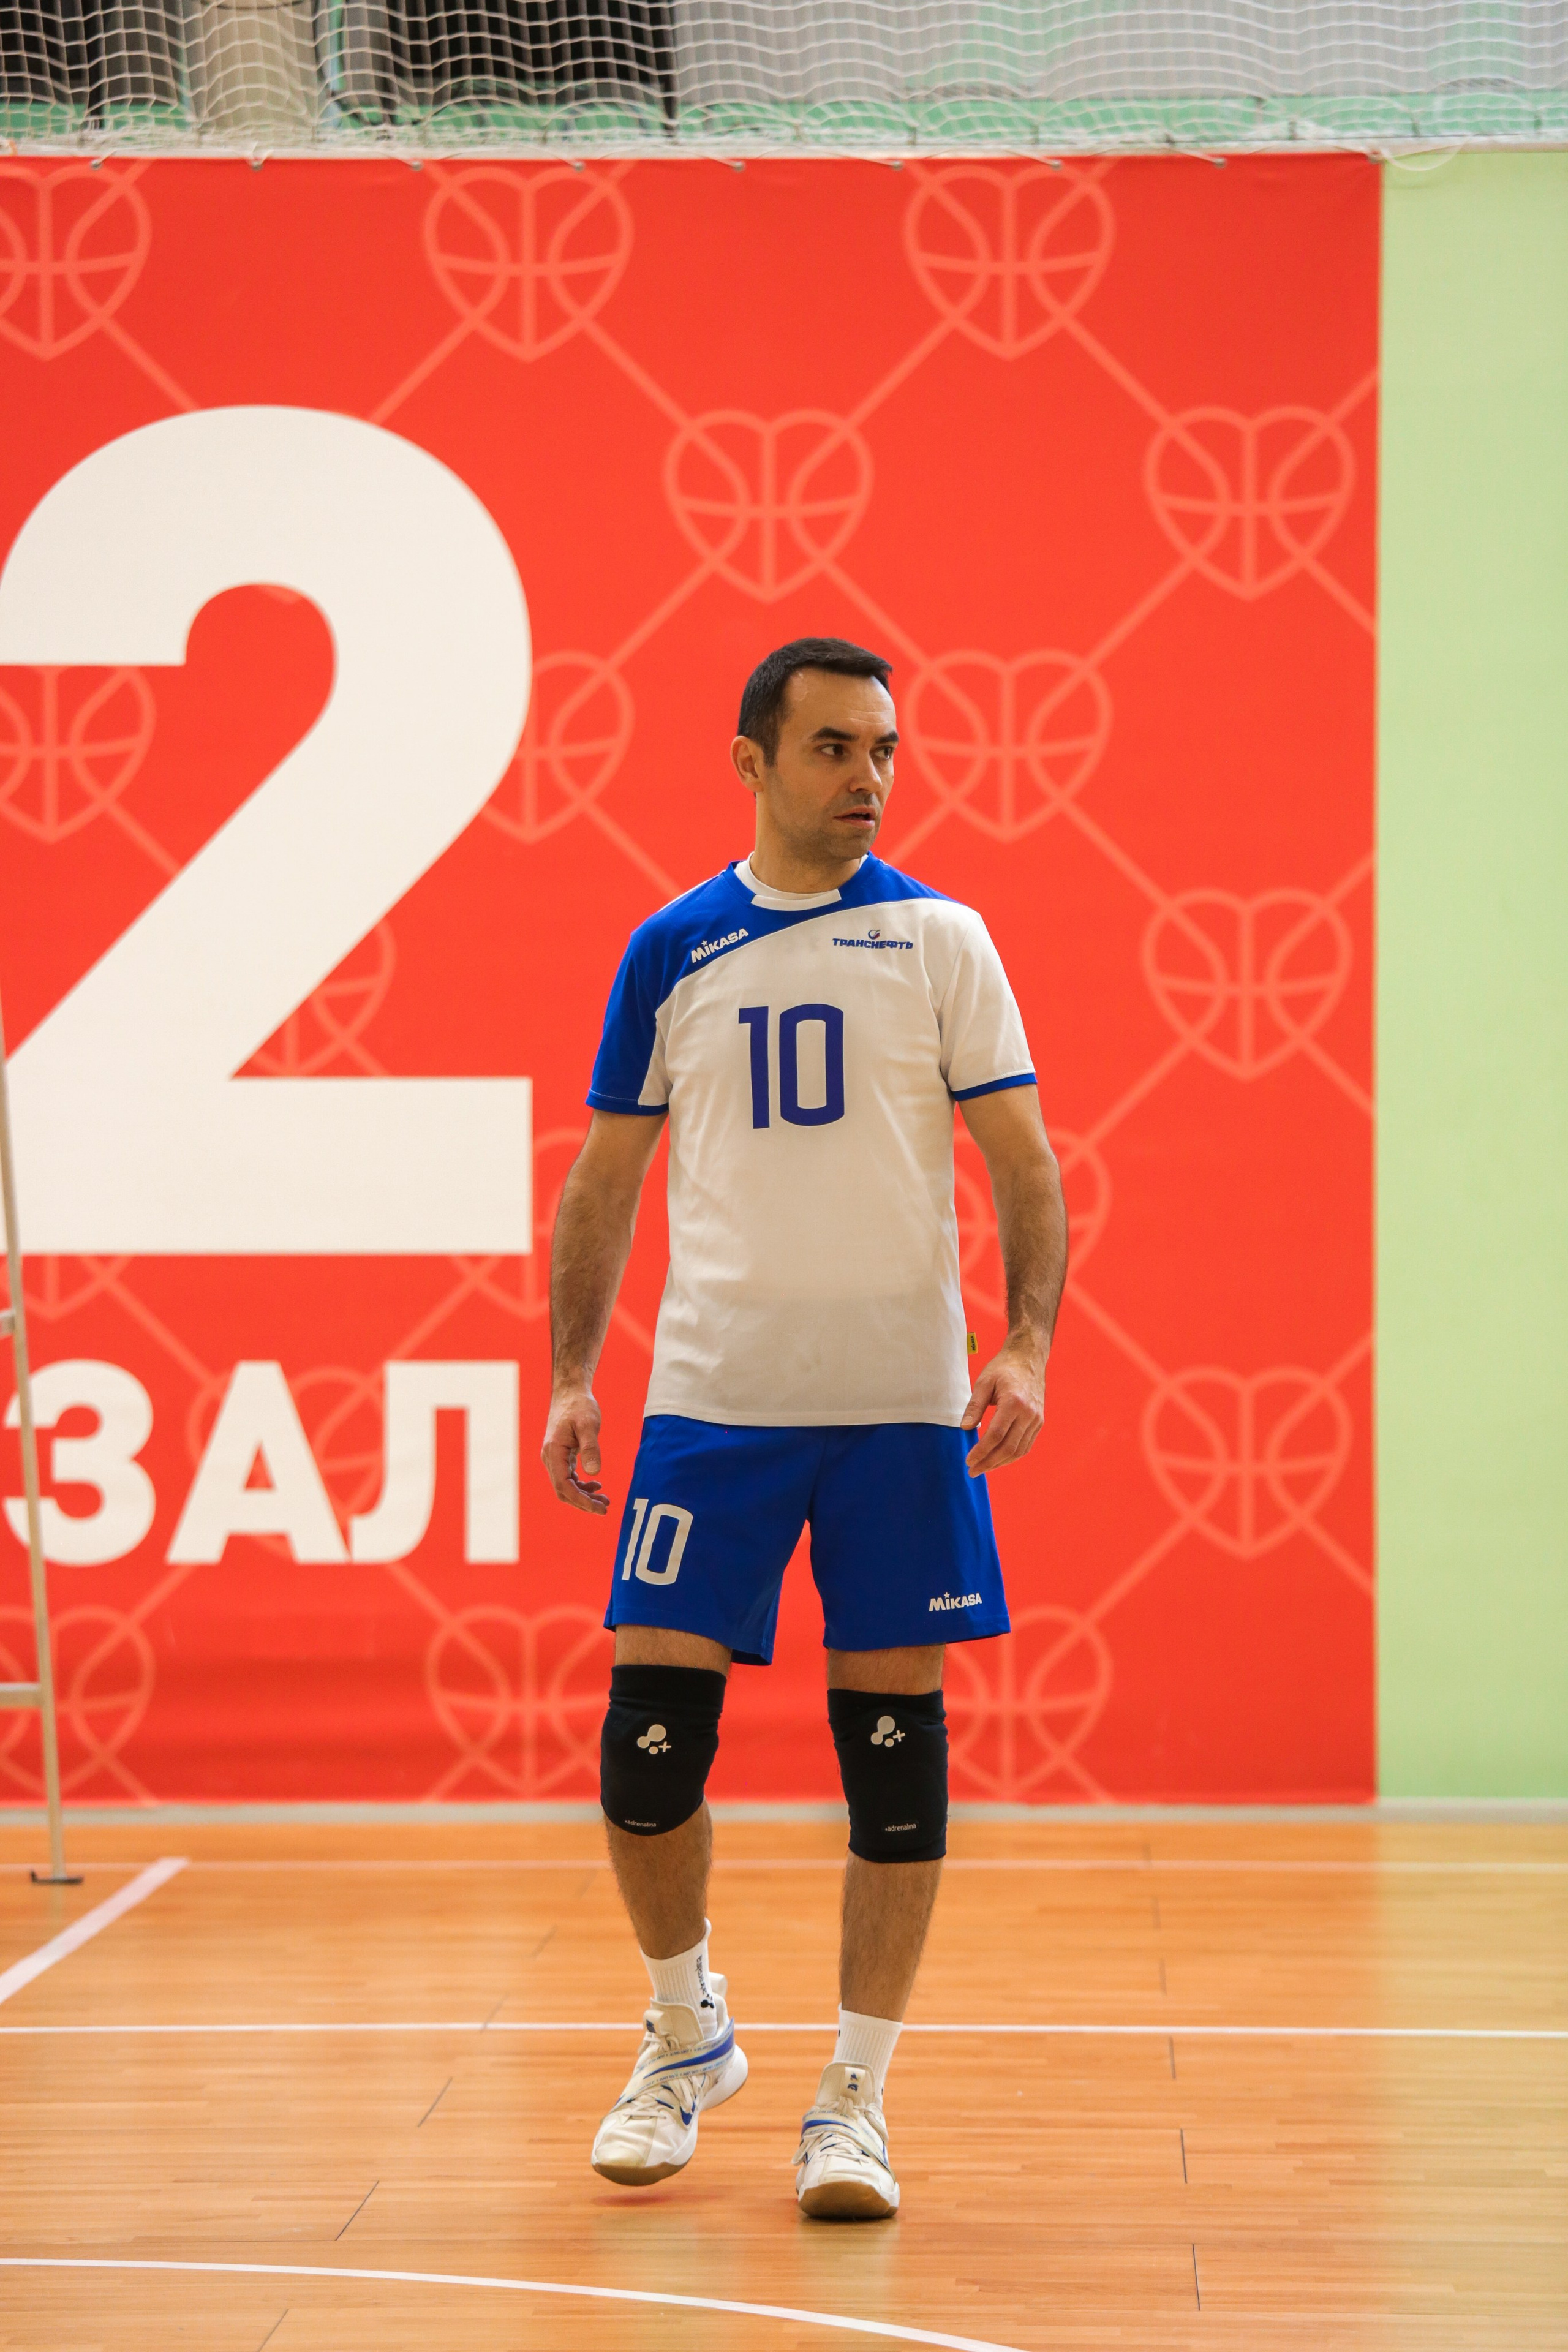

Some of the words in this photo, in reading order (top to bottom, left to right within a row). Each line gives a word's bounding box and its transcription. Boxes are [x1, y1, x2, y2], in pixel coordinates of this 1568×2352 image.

[0, 404, 533, 1255] 2
[832, 938, 913, 949] ТРАНСНЕФТЬ
[738, 1003, 845, 1129] 10
[3, 1359, 519, 1566] ЗАЛ
[621, 1498, 693, 1586] 10
